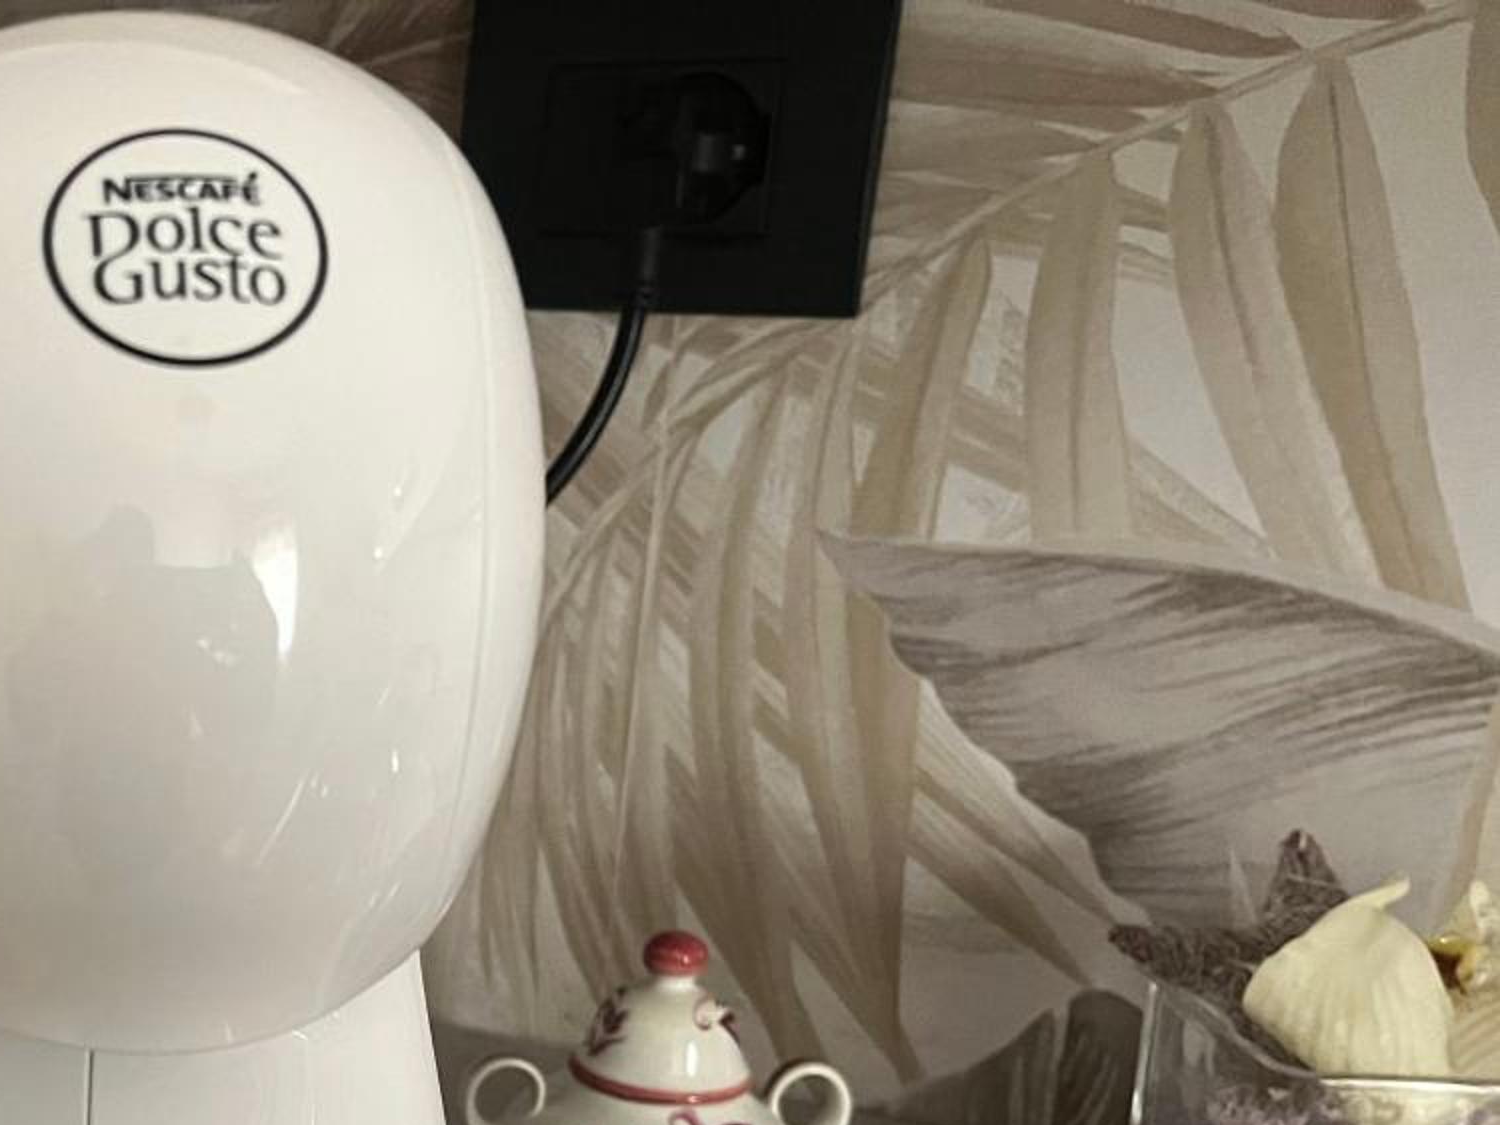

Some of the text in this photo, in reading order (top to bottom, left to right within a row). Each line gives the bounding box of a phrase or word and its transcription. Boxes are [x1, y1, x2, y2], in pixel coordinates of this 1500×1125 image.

[102, 171, 263, 206] NESCAFÉ
[84, 206, 283, 260] Dolce
[93, 256, 287, 306] Gusto
